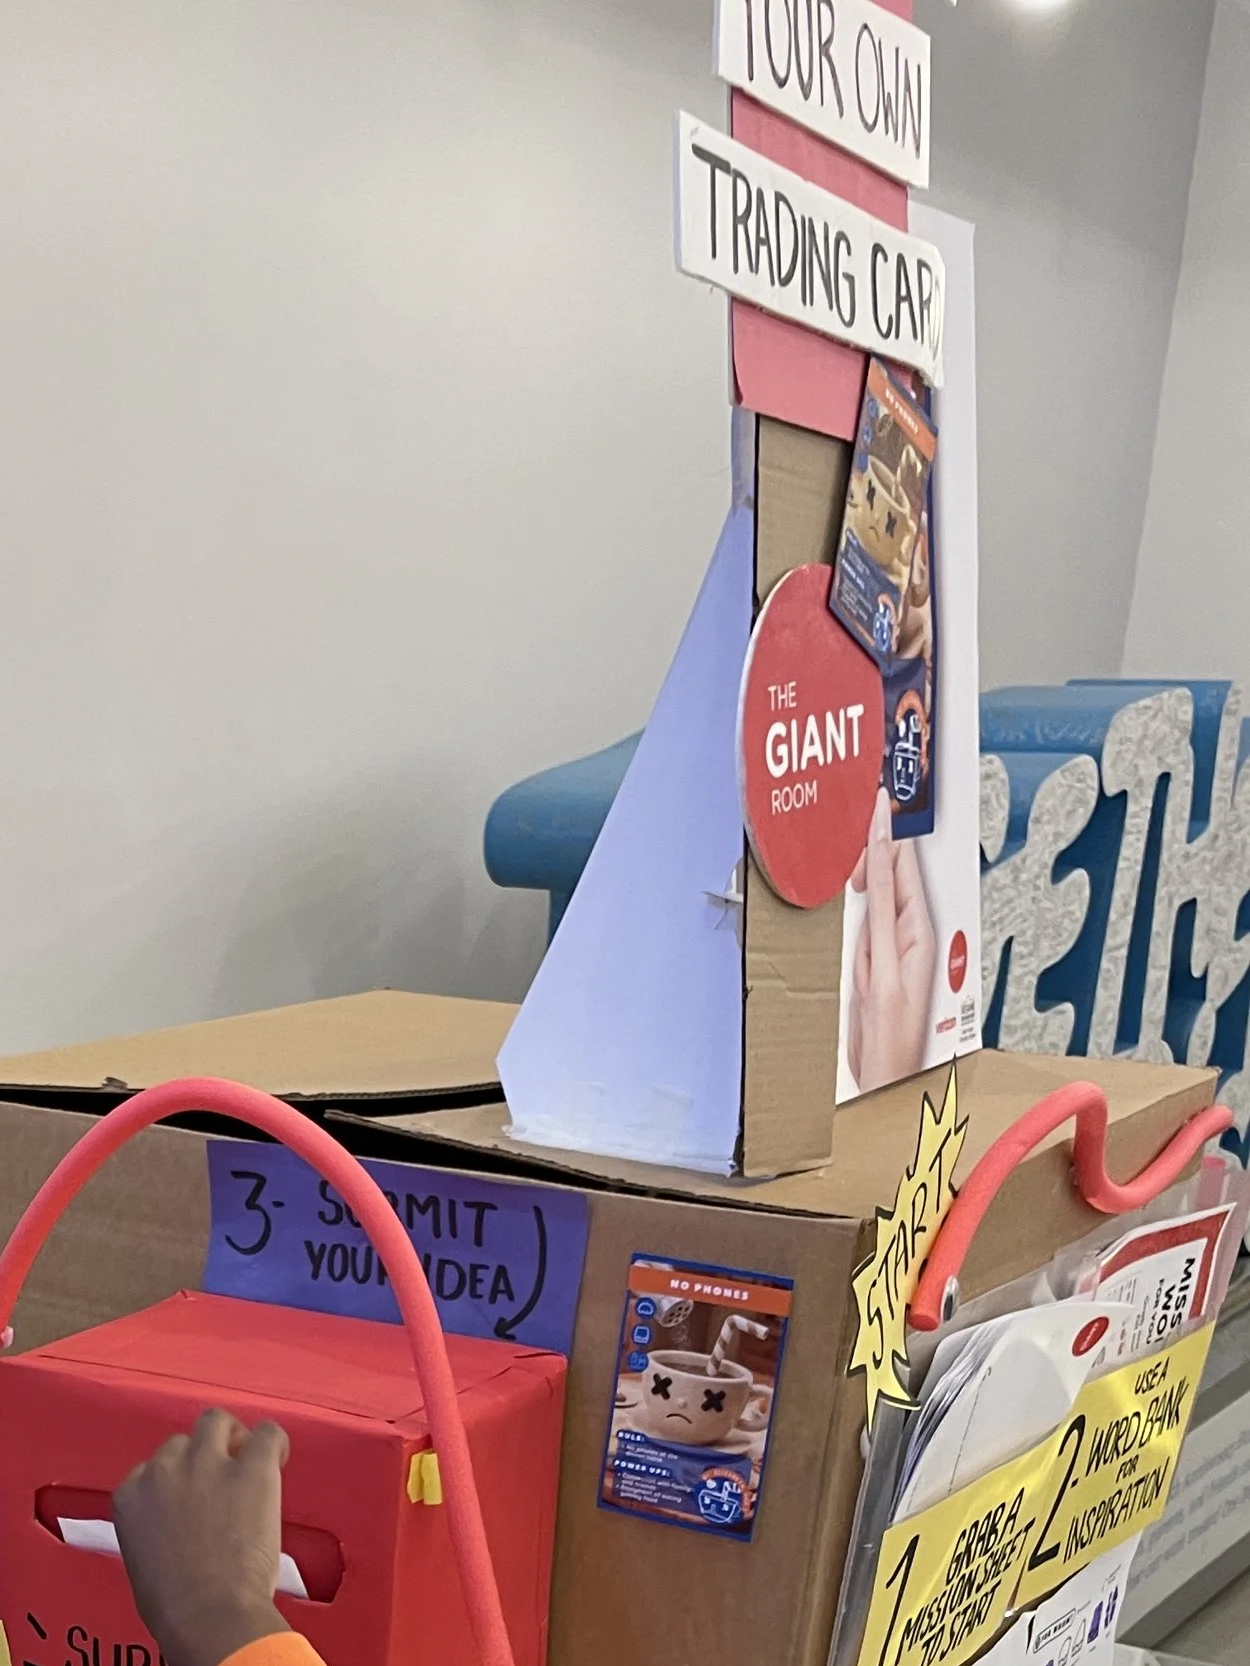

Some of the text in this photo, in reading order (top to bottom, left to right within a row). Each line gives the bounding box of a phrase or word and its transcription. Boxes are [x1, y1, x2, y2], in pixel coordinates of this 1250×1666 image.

[855, 22, 922, 160] OWN
[691, 143, 856, 328] TRADING
[767, 681, 797, 711] THE
[765, 704, 865, 778] GIANT
[771, 779, 818, 815] ROOM
[318, 1179, 498, 1248] SMIT
[867, 1127, 952, 1370] START
[670, 1279, 749, 1301] NO PHONES
[1170, 1257, 1196, 1330] MISS
[1134, 1356, 1170, 1395] USE A
[1085, 1411, 1141, 1477] WORD
[1138, 1375, 1190, 1449] BANK
[1116, 1454, 1139, 1484] FOR
[946, 1487, 1025, 1587] GRAB A
[1063, 1456, 1171, 1564] INSPIRATION
[975, 1517, 1036, 1594] SHEET
[939, 1579, 1002, 1662] START
